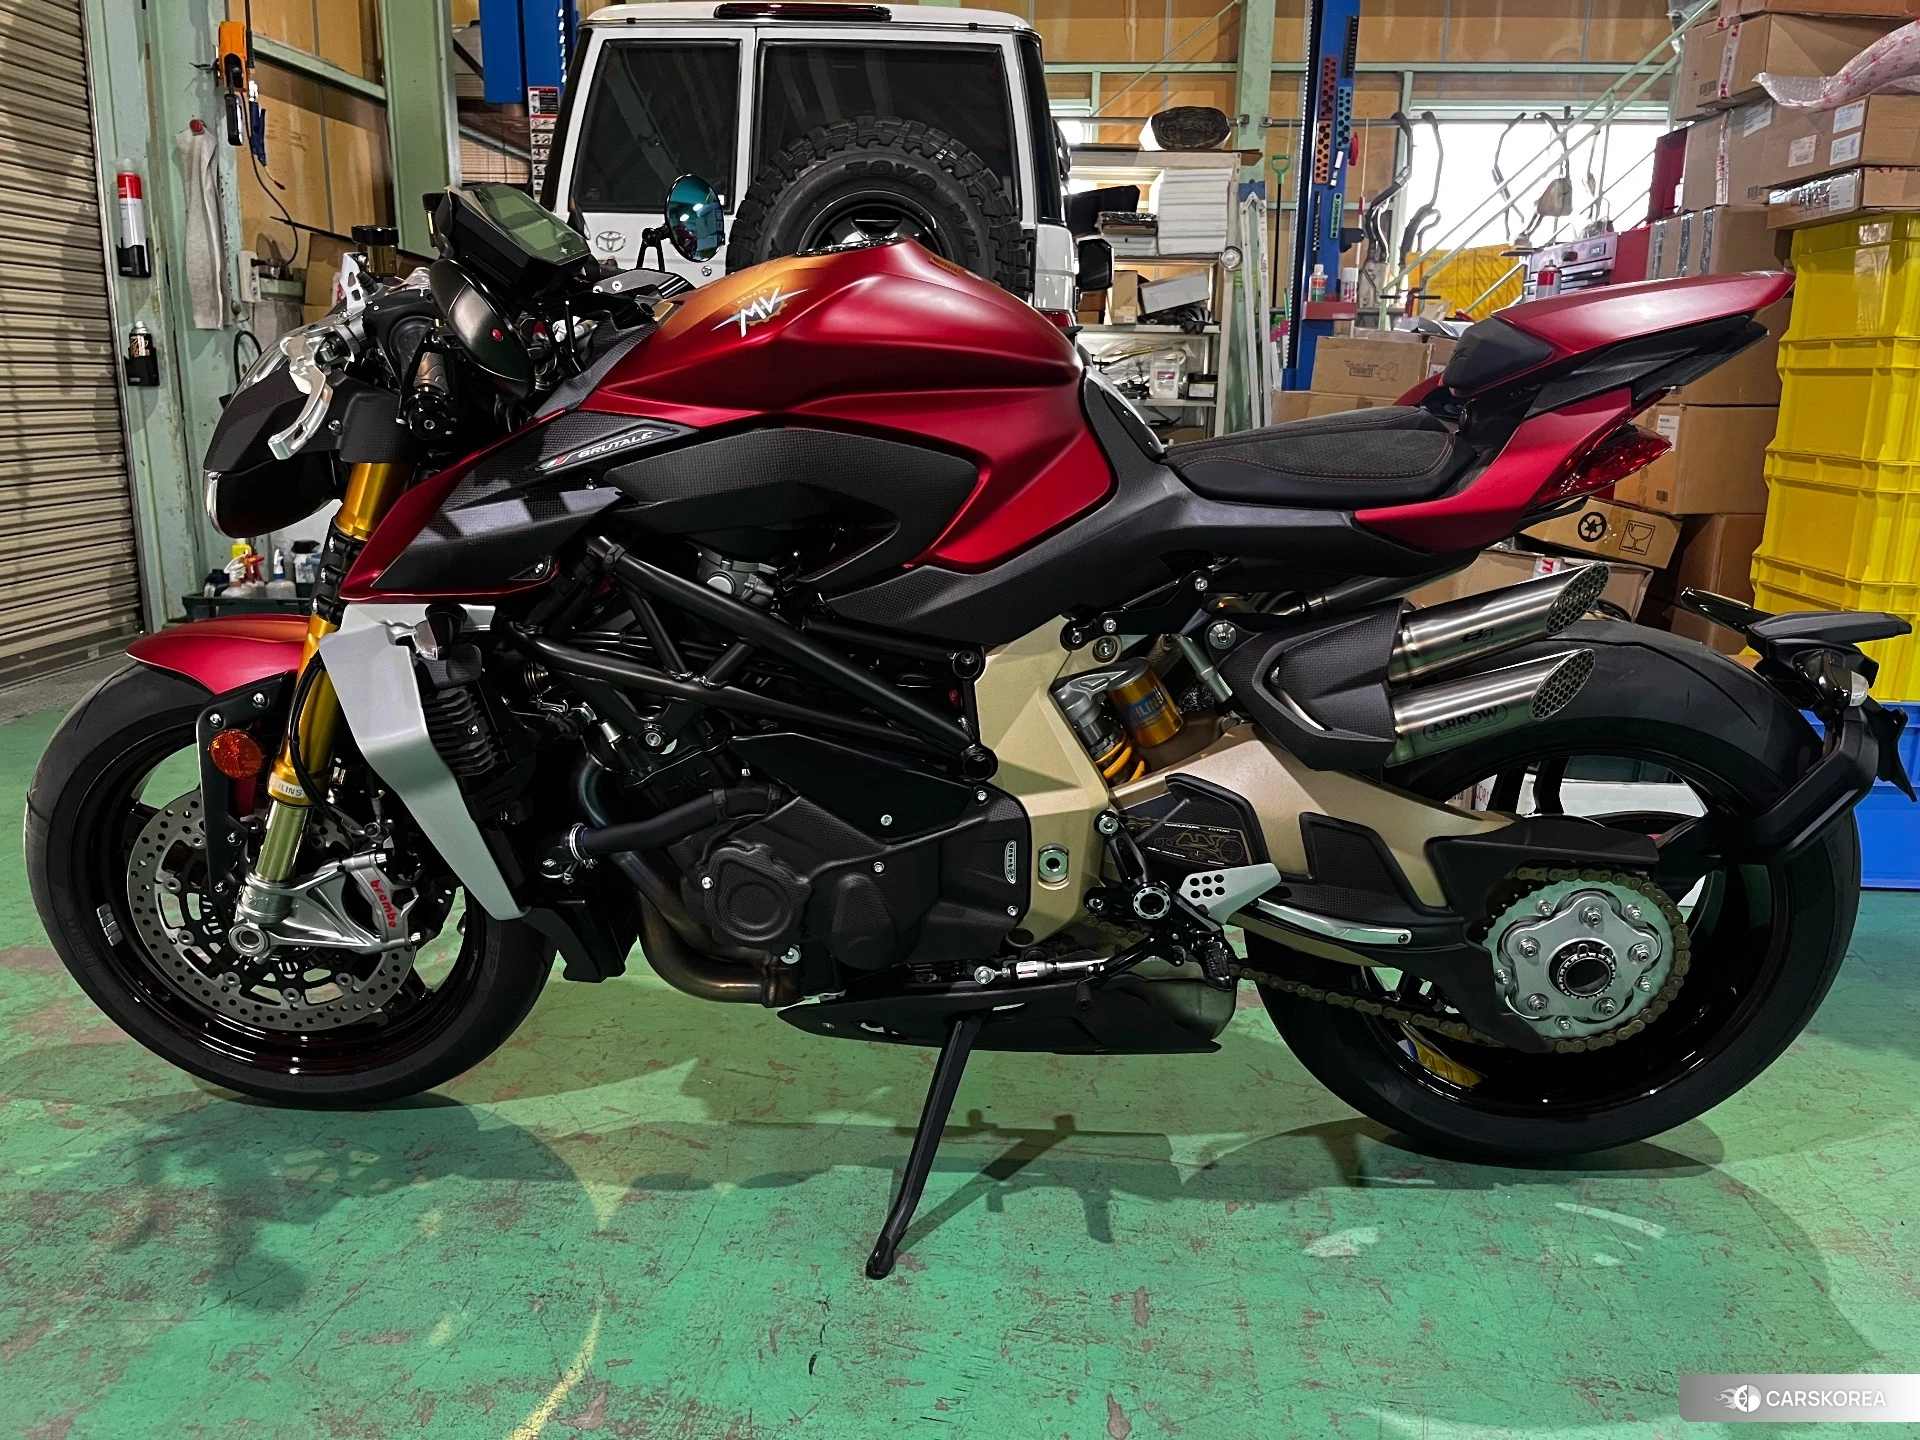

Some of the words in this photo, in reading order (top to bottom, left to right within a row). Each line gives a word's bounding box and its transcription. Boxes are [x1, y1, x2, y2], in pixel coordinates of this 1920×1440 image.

[845, 160, 937, 191] TOYO
[740, 286, 781, 338] MV
[578, 431, 653, 459] BRUTALE
[1430, 706, 1498, 734] ARROW
[370, 879, 397, 928] brembo
